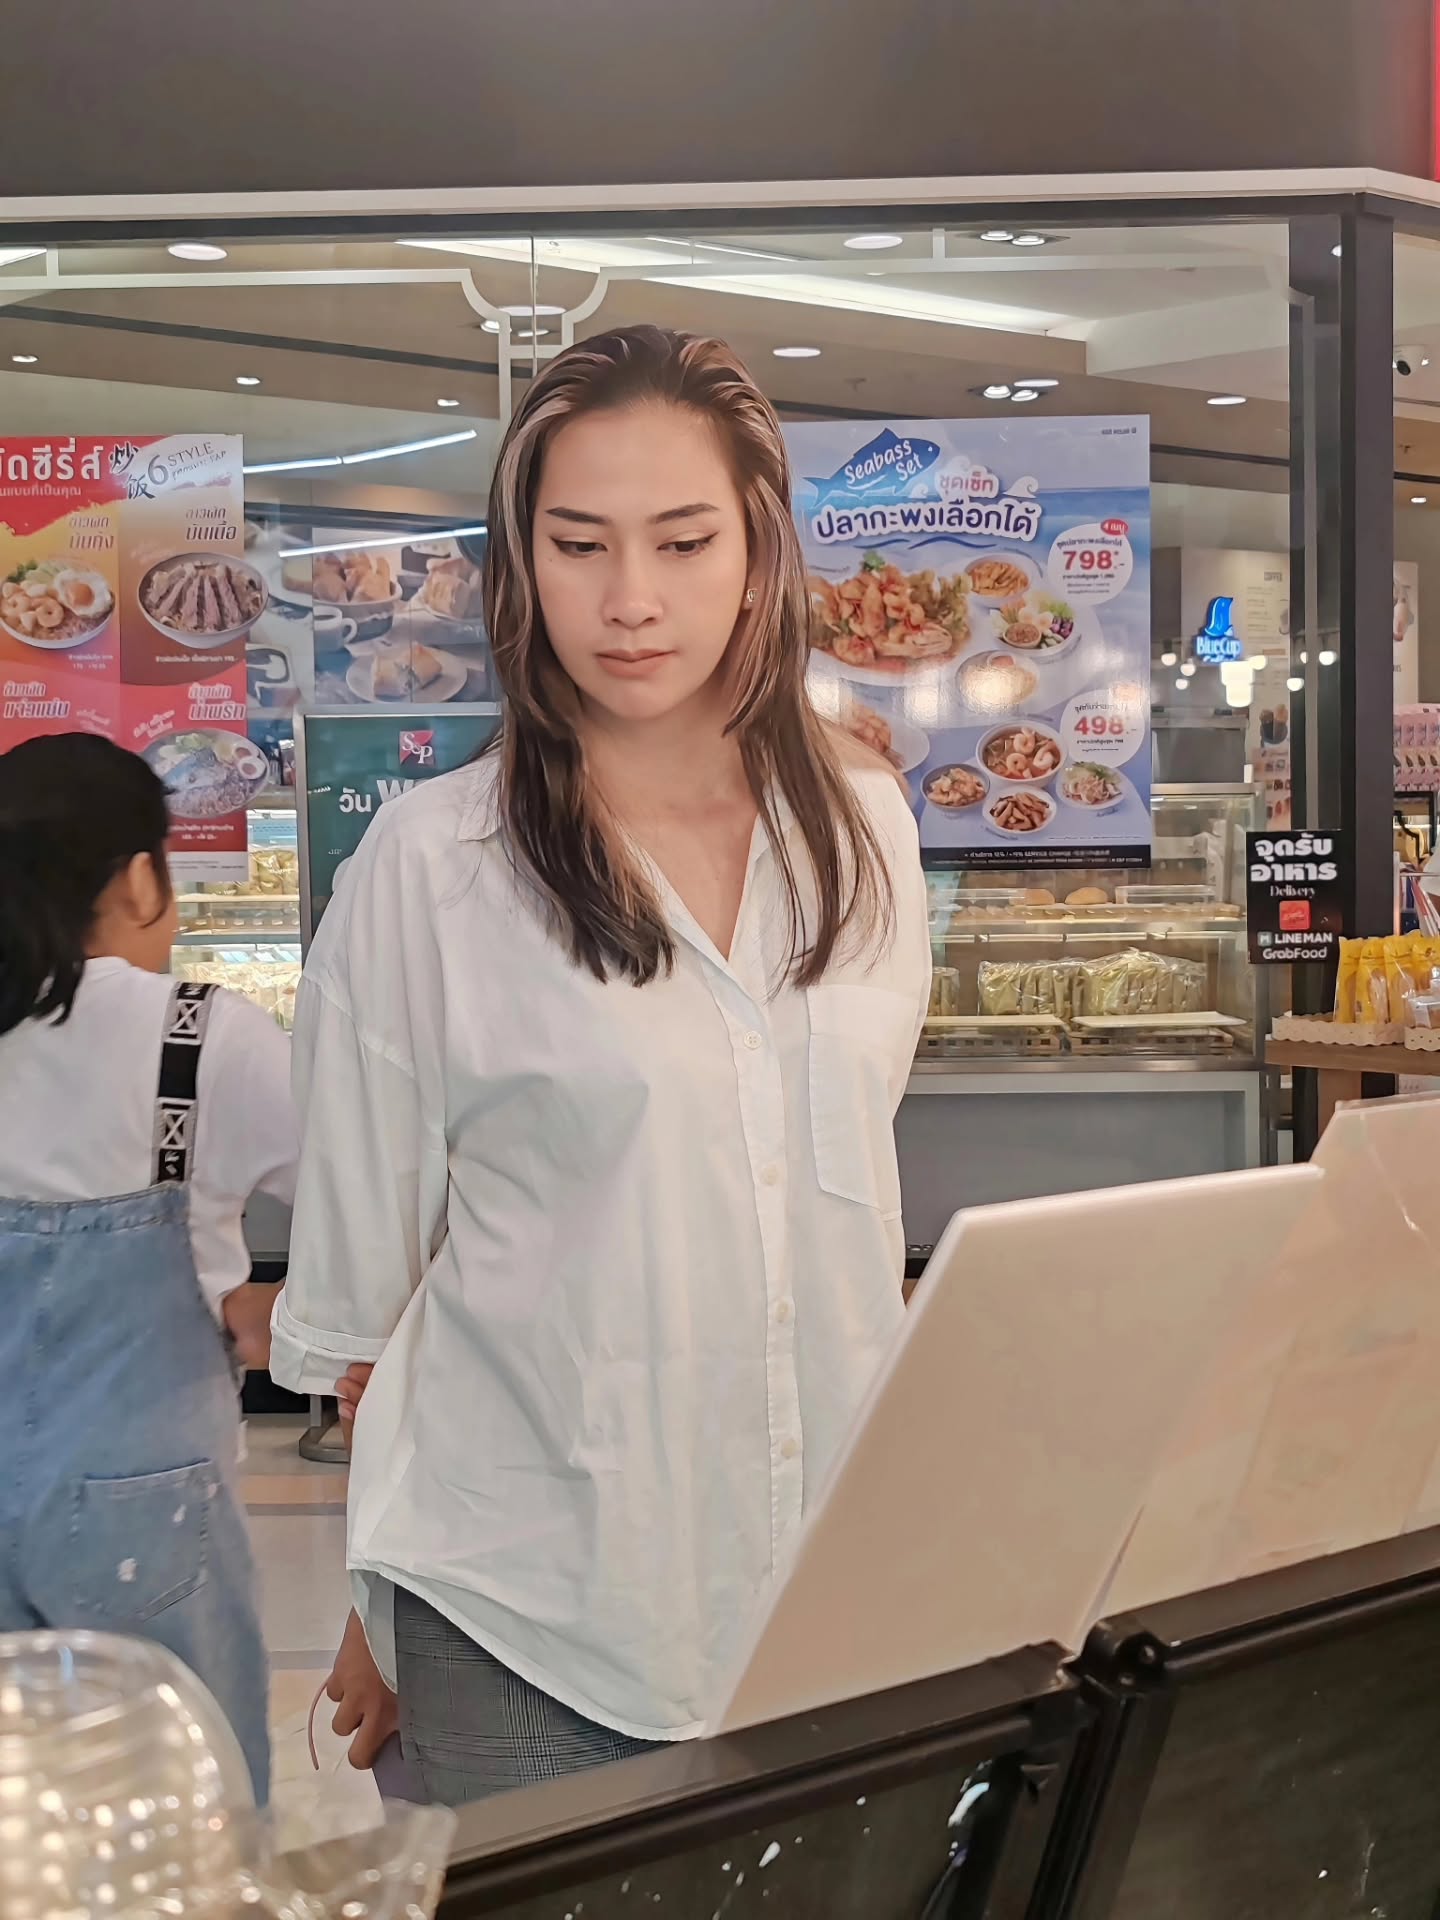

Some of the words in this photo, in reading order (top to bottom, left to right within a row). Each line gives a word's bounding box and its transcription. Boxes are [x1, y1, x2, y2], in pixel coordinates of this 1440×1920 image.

[147, 454, 169, 486] 6
[167, 441, 214, 467] STYLE
[844, 439, 912, 485] Seabass
[895, 452, 924, 482] Set
[816, 498, 1036, 539] ปลากะพงเลือกได้
[338, 787, 372, 813] วัน
[1255, 832, 1334, 862] จุดรับ
[1250, 862, 1339, 882] อาหาร
[1262, 946, 1329, 960] GrabFood
[1274, 933, 1303, 945] LINE
[1303, 932, 1334, 944] MAN
